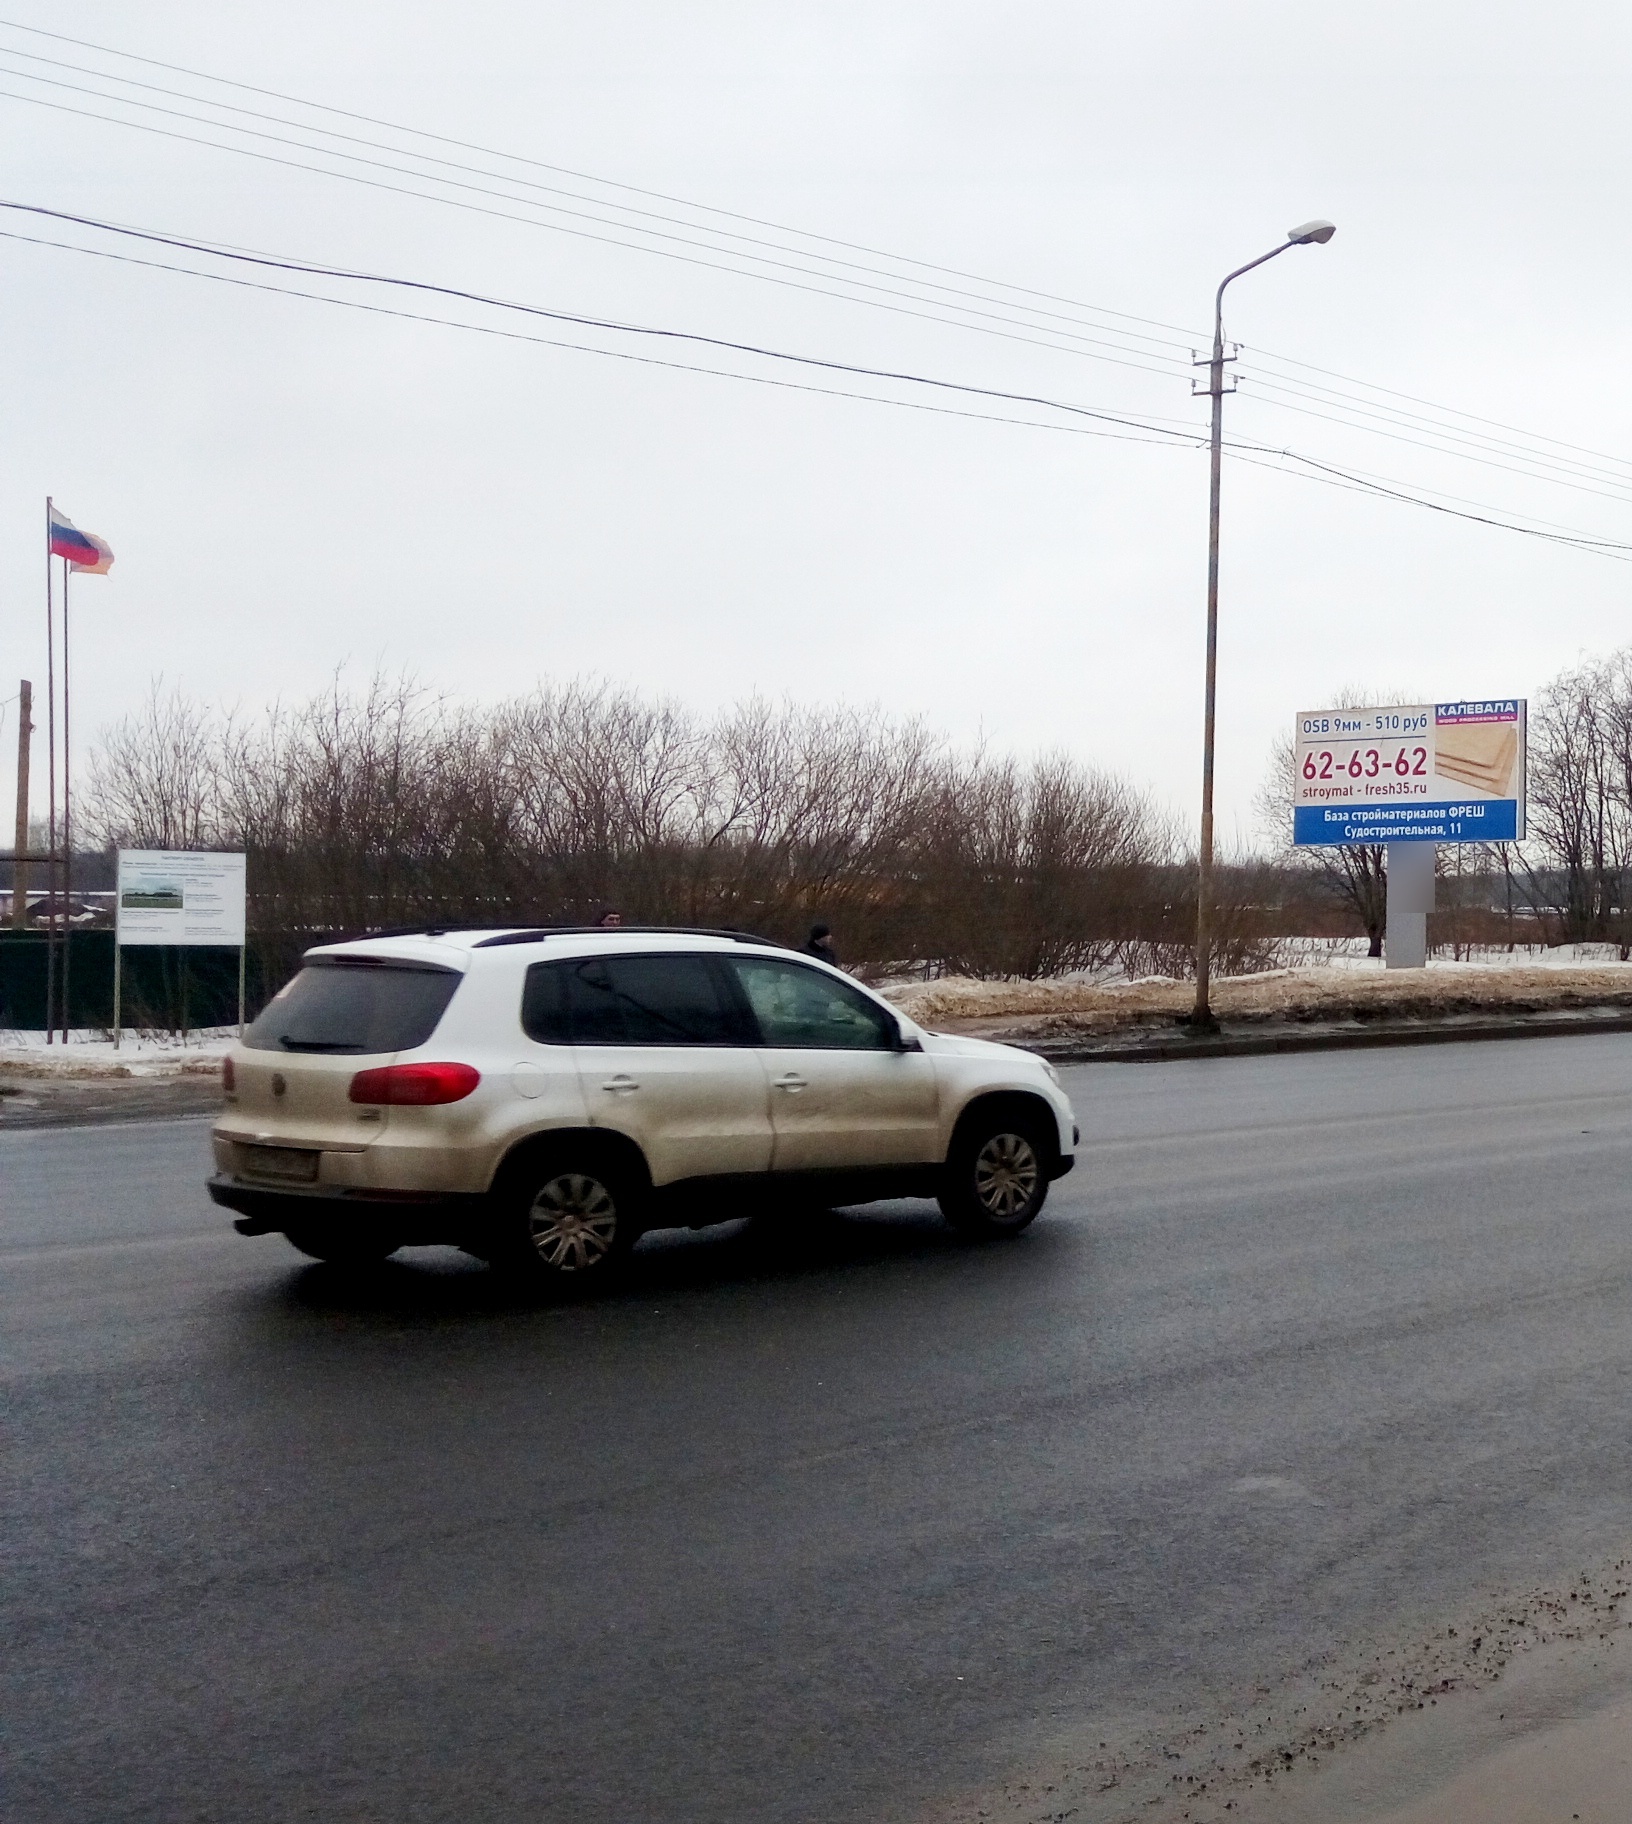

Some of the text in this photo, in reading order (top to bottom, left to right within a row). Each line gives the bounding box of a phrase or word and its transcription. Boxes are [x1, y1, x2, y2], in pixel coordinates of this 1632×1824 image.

[1437, 701, 1515, 716] КАЛЕВАЛА
[1303, 718, 1330, 733] OSB
[1334, 718, 1361, 731] 9мм
[1375, 714, 1399, 730] 510
[1403, 713, 1428, 732] руб
[1302, 746, 1427, 780] 62-63-62
[1302, 785, 1353, 800] stroymat
[1365, 781, 1427, 796] fresh35.ru
[1324, 805, 1485, 823] База стройматериалов ФРЕШ
[1344, 822, 1462, 839] Судостроительная, 11
